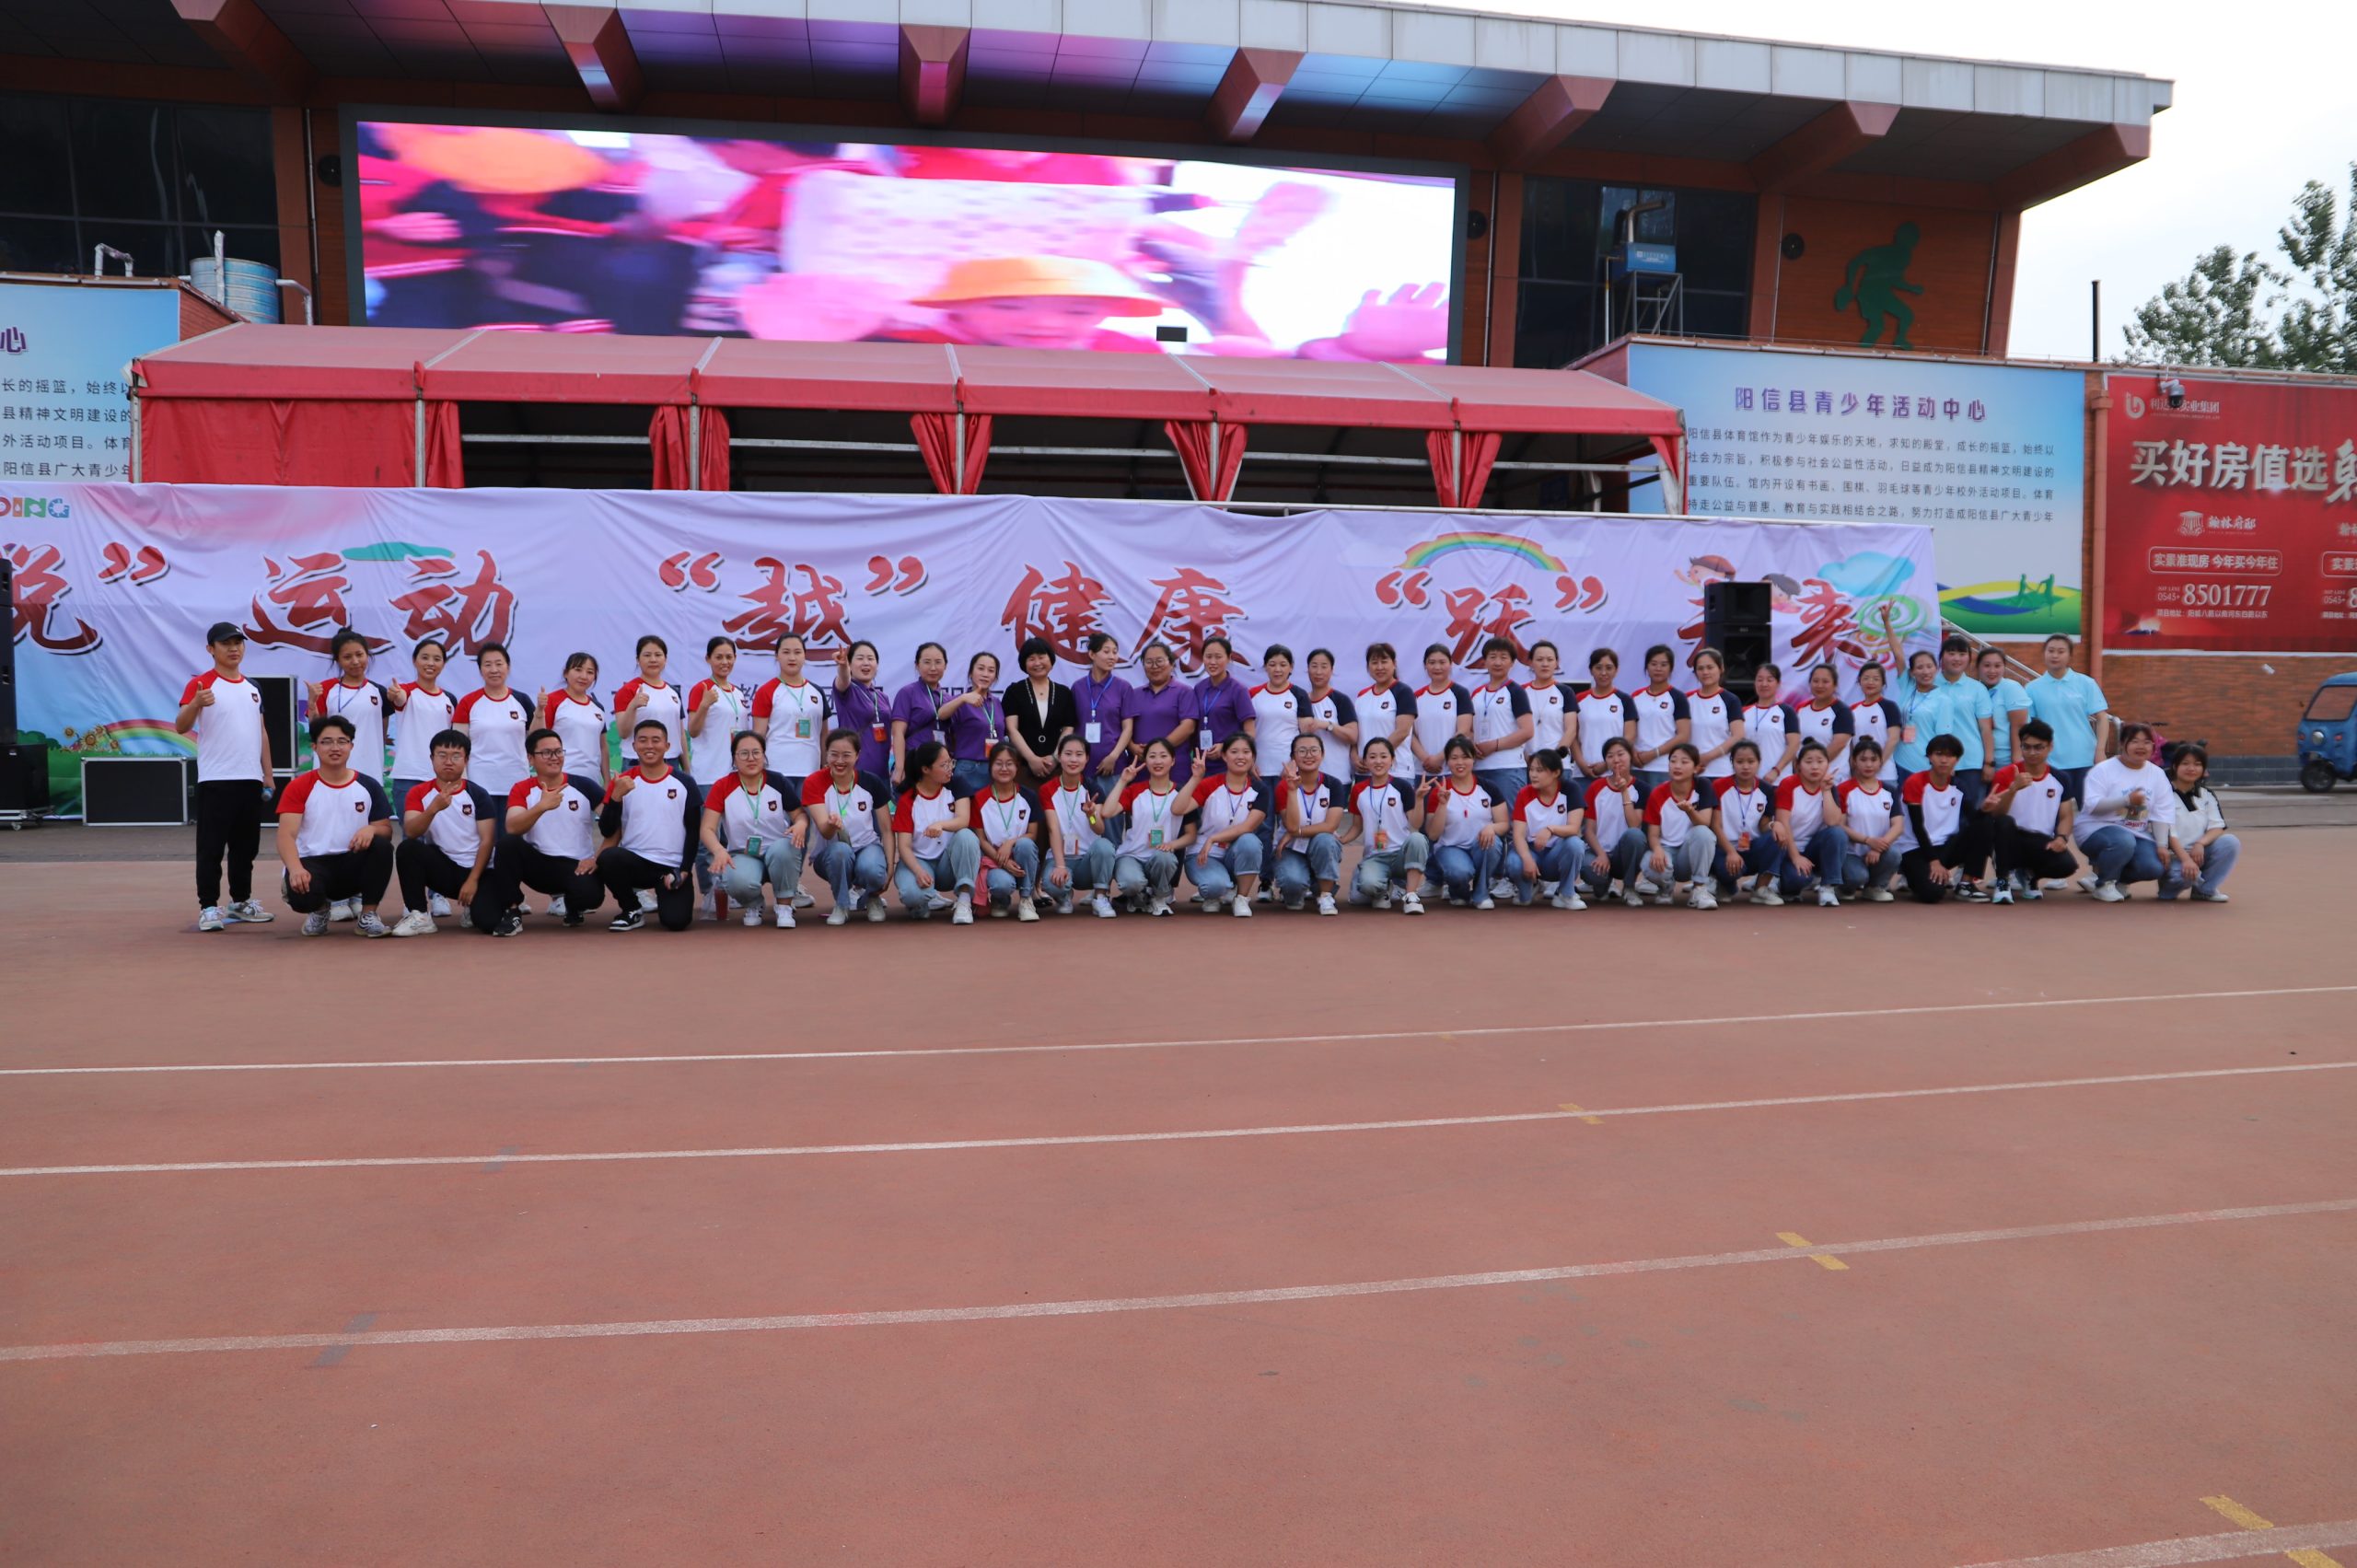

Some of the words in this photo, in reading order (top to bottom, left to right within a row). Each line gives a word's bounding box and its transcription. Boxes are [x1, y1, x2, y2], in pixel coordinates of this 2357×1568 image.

[1735, 387, 1986, 422] 阳信县青少年活动中心
[2183, 583, 2272, 606] 8501777
